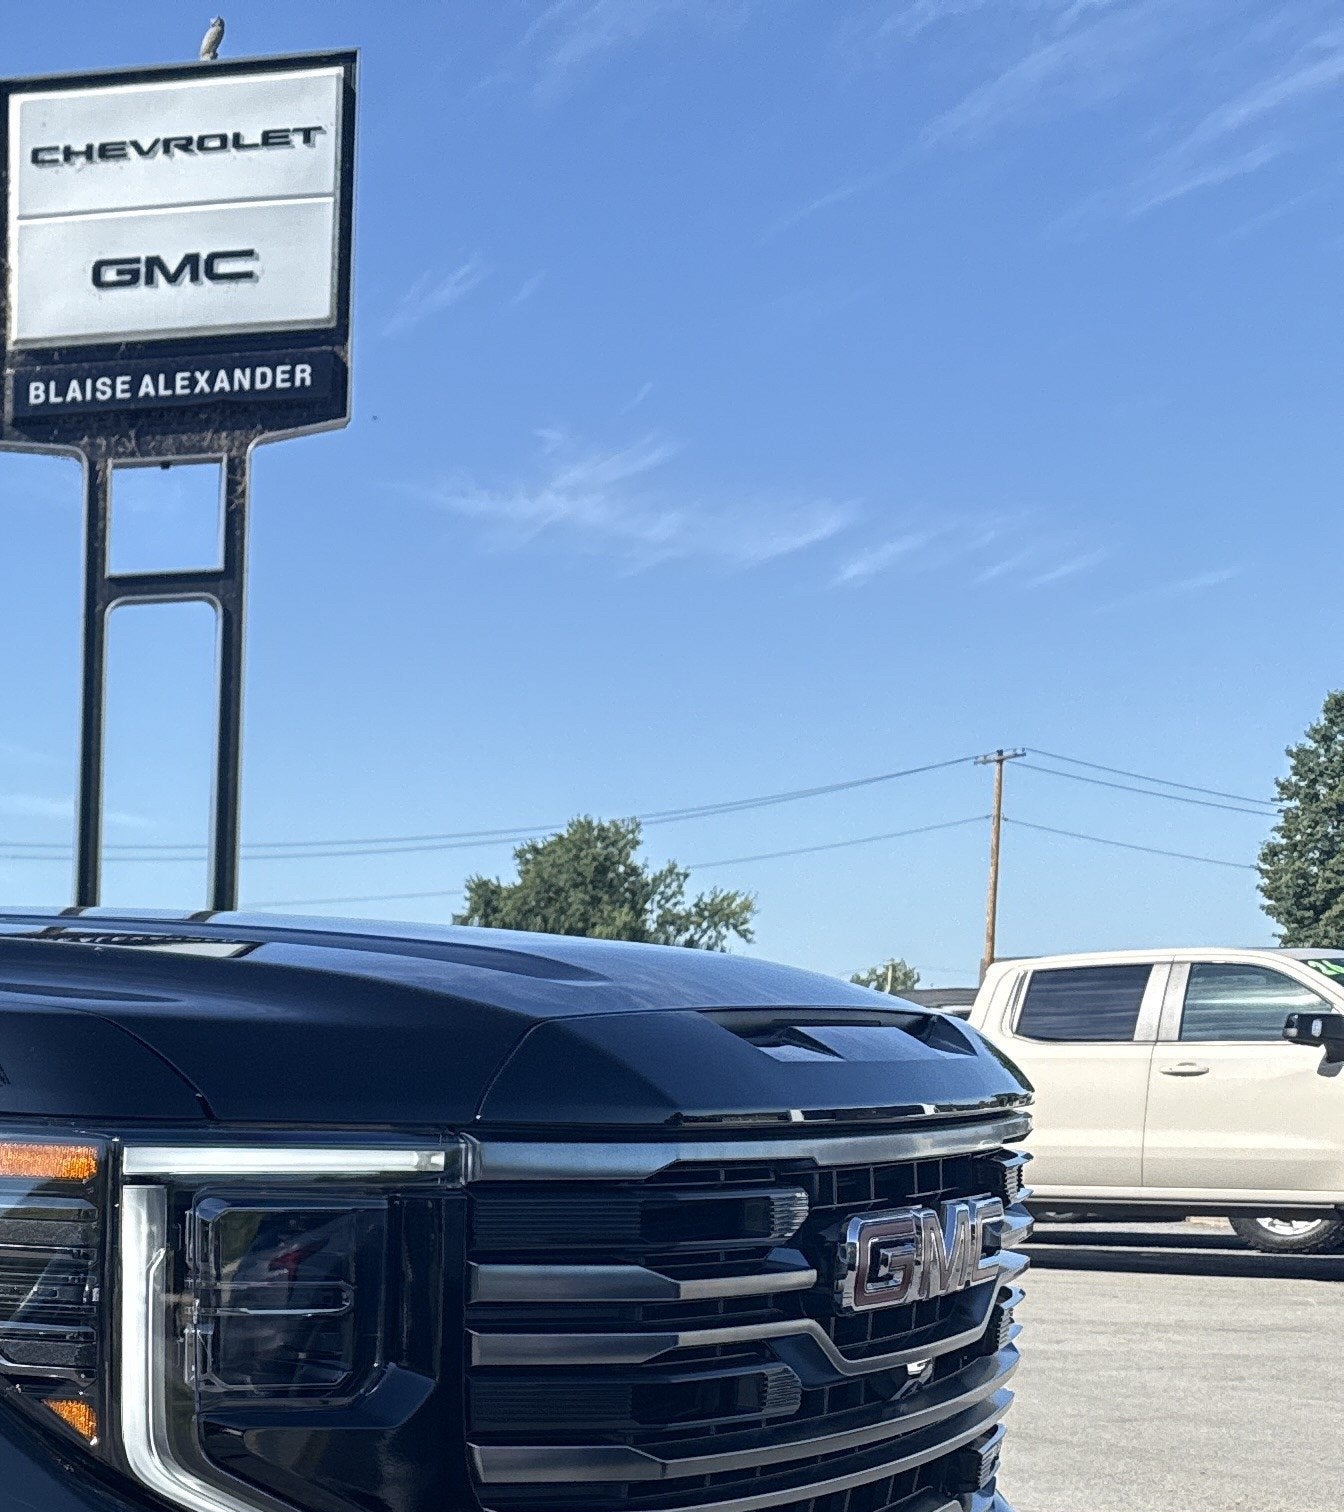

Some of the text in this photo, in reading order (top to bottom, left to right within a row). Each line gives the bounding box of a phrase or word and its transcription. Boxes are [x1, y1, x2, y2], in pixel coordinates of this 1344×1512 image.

[30, 126, 324, 166] CHEVROLET
[92, 249, 257, 290] GMC
[28, 363, 312, 405] BLAISE ALEXANDER
[847, 1197, 1005, 1311] GMC
